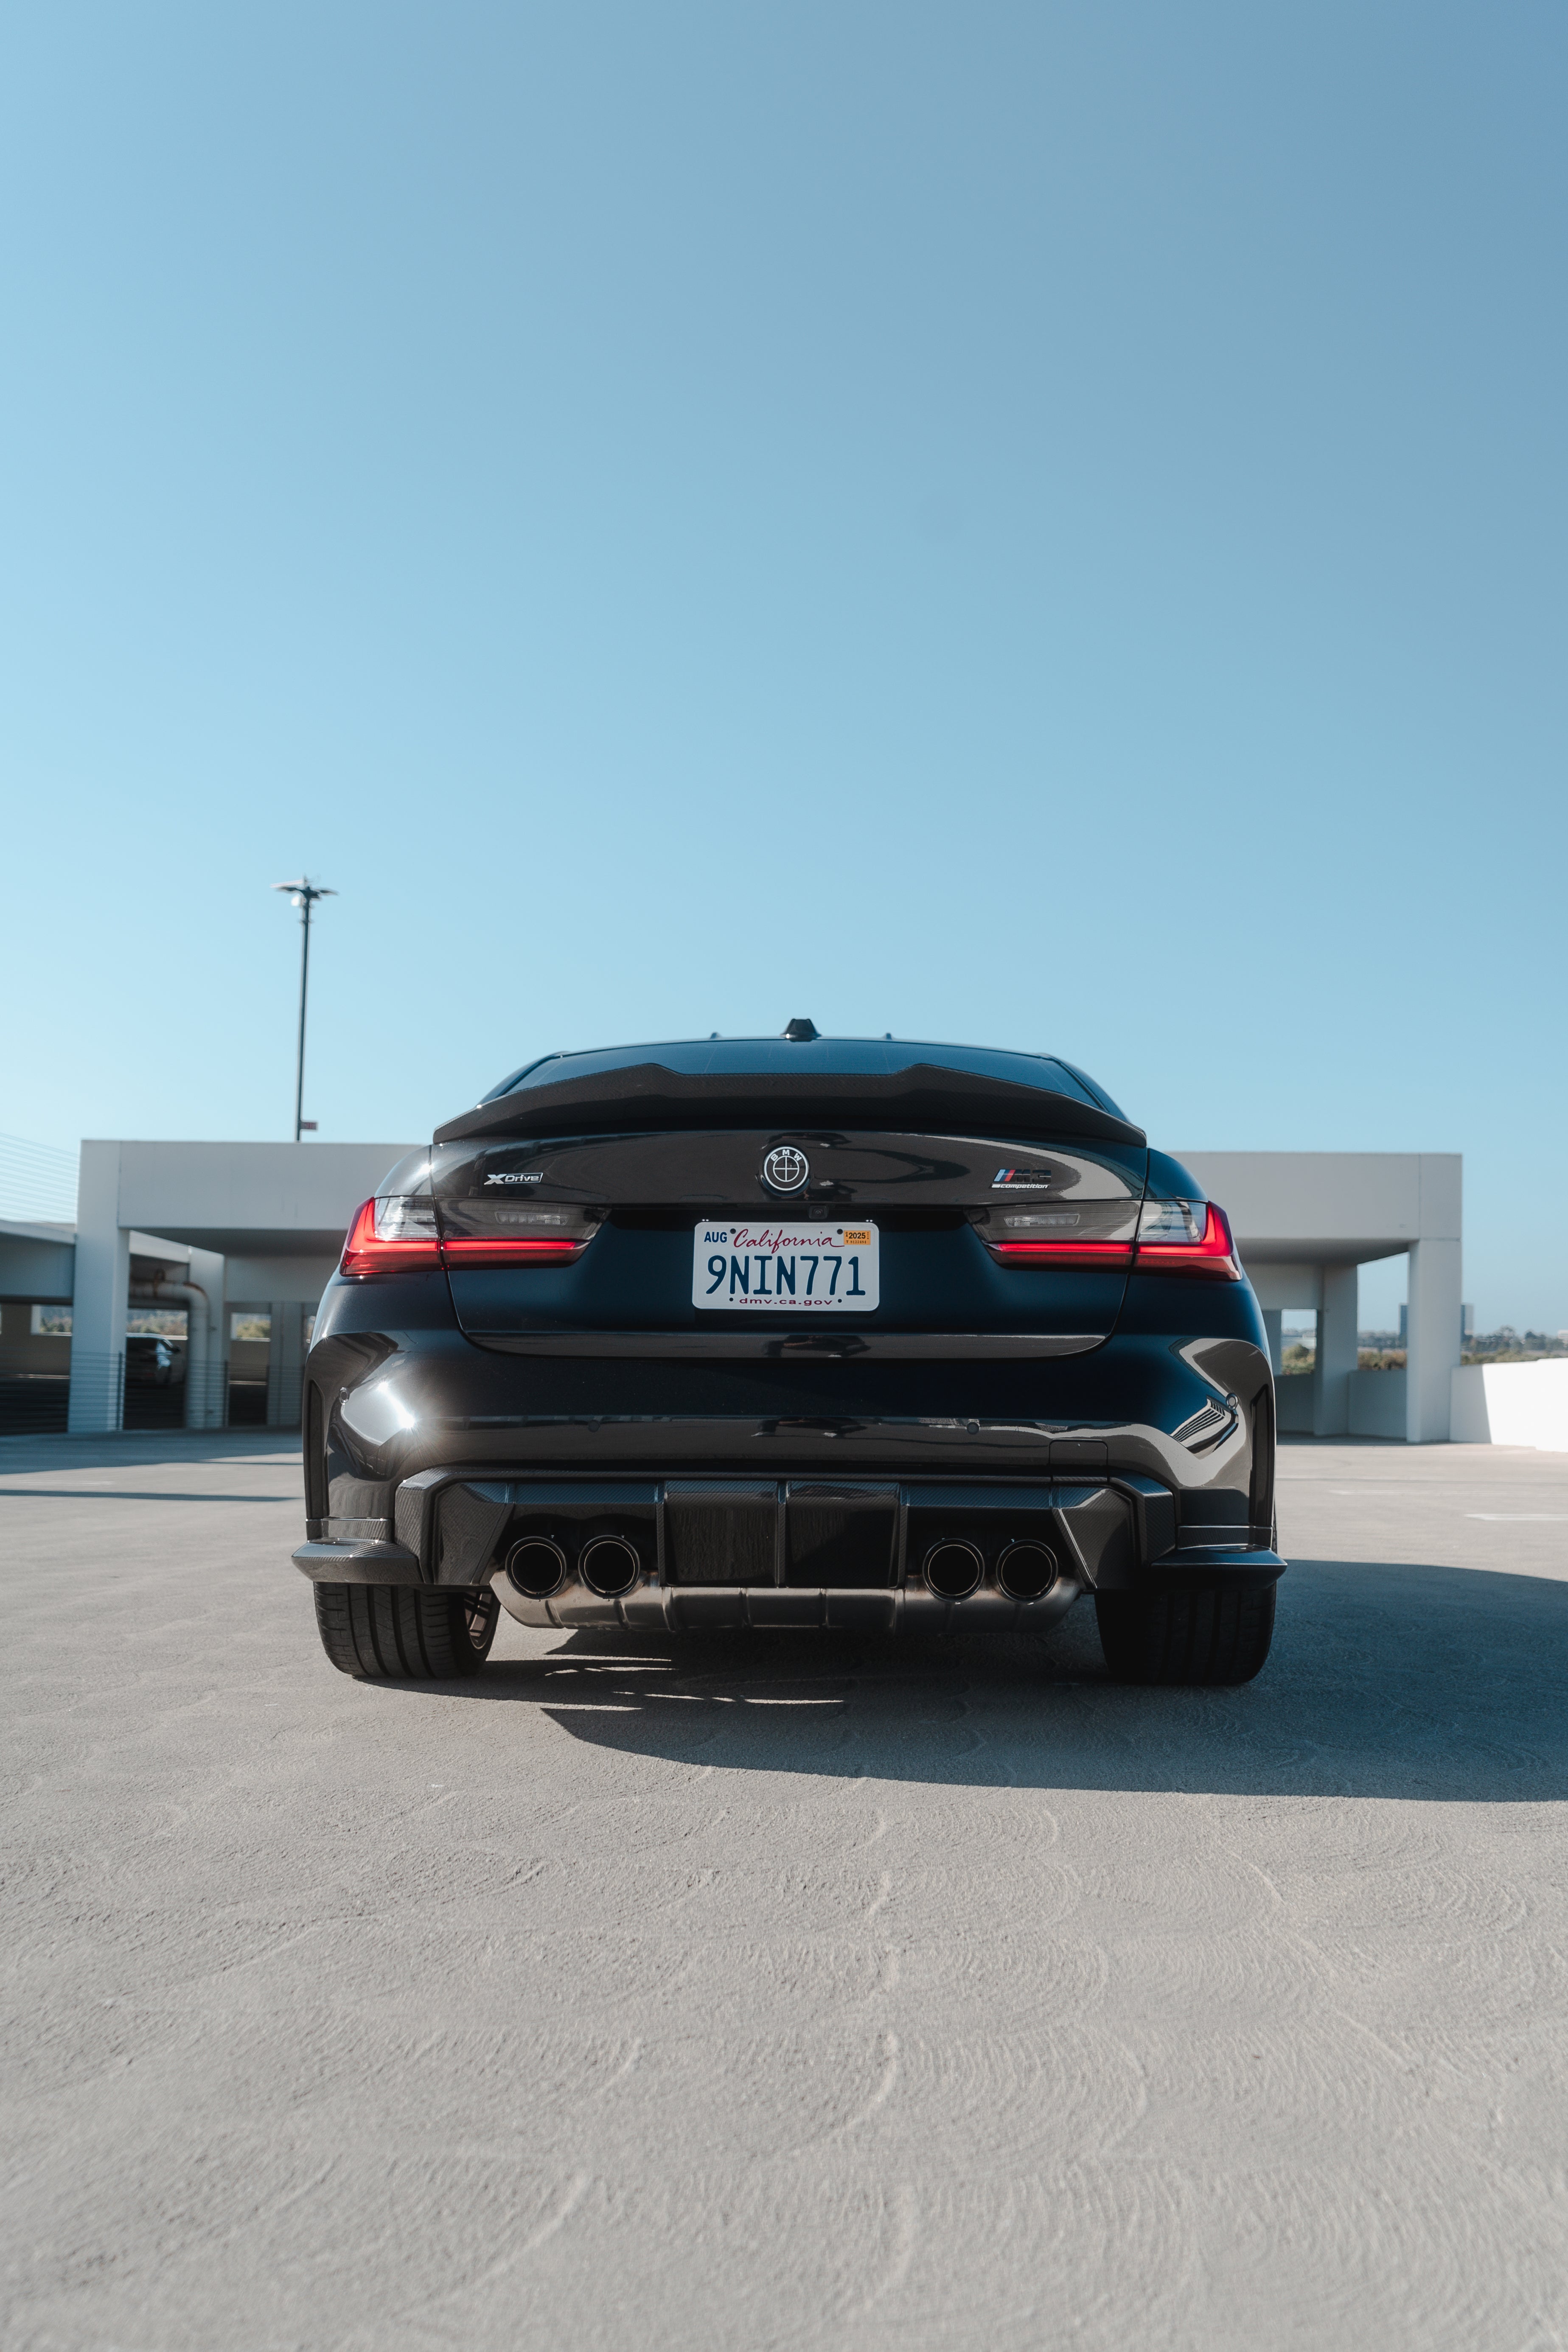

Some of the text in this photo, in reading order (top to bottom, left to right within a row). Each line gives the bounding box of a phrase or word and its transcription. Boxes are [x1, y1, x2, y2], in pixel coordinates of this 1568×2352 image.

[770, 1149, 802, 1161] BMW
[1010, 1169, 1051, 1183] M3
[704, 1231, 727, 1243] AUG
[733, 1229, 845, 1253] California
[706, 1255, 866, 1295] 9NIN771
[739, 1298, 833, 1306] dmv.ca.gov
